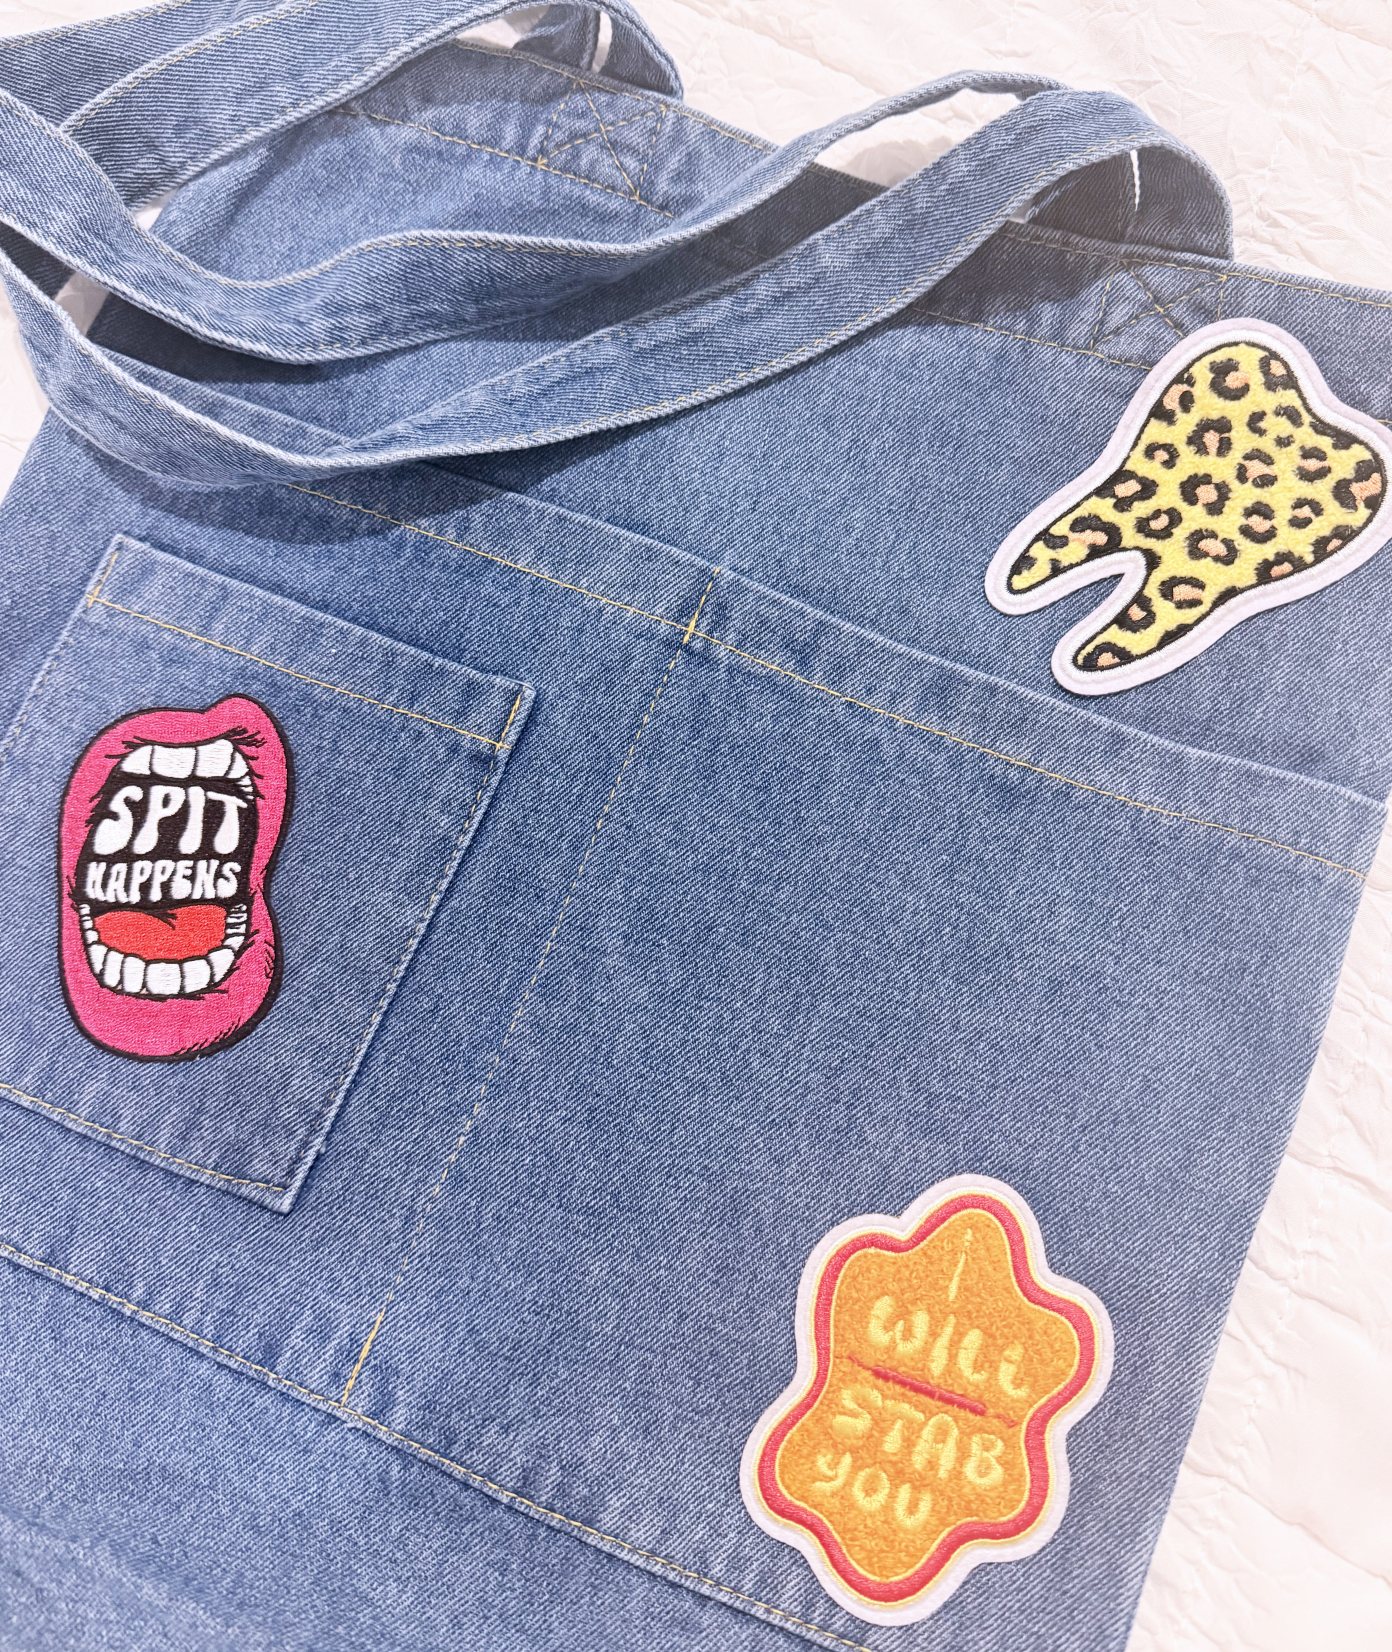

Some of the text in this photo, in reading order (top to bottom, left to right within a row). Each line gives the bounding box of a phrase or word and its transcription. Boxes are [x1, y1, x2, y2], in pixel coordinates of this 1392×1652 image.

[94, 785, 247, 855] SPIT
[86, 859, 241, 903] HAPPENS
[867, 1295, 1029, 1397] WILL
[832, 1387, 1005, 1486] STAB
